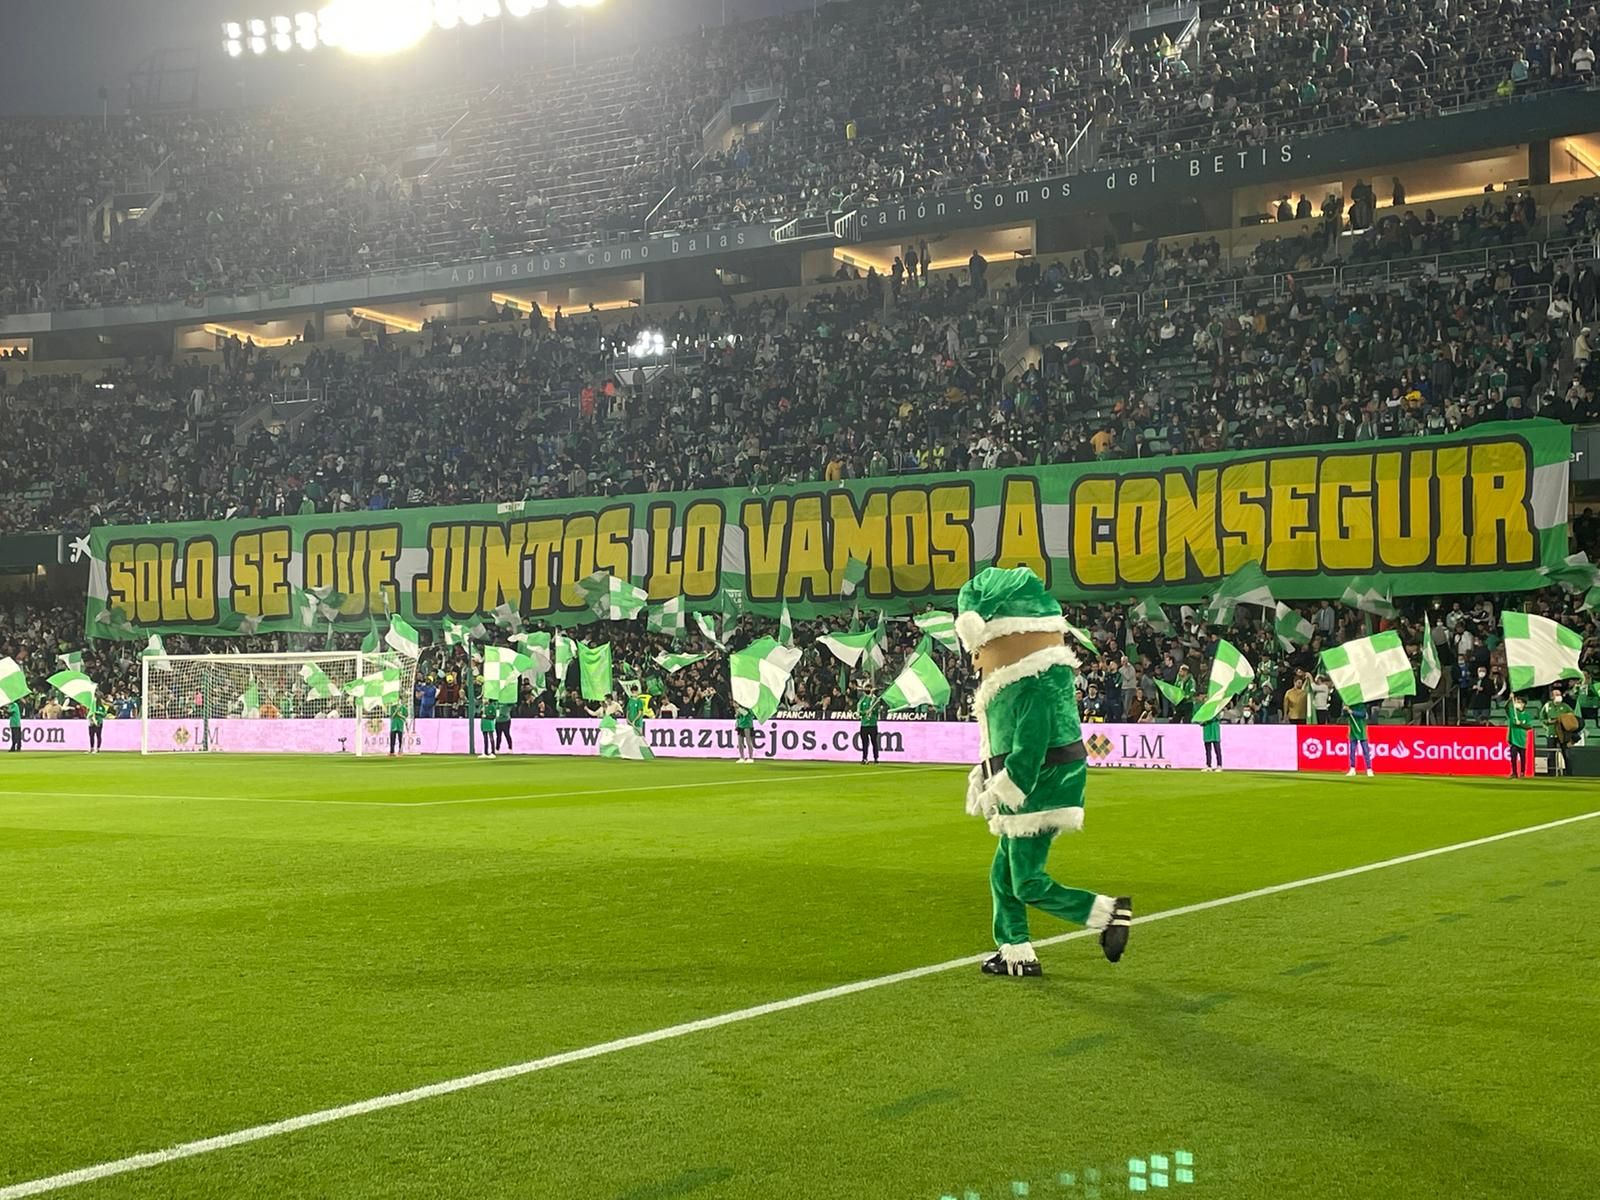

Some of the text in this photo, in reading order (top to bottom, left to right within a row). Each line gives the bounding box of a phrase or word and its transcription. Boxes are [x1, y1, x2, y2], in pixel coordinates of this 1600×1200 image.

[588, 245, 649, 264] como
[672, 231, 744, 253] balas
[974, 183, 1071, 209] Somos
[1107, 166, 1155, 189] del
[106, 534, 218, 625] SOLO
[230, 525, 293, 620] SE
[412, 503, 635, 619] JUNTOS
[645, 499, 726, 602] LO
[742, 480, 975, 602] VAMOS
[994, 474, 1051, 592] A
[1068, 434, 1540, 591] CONSEGUIR
[776, 711, 816, 720] #FANCAM
[886, 713, 928, 721] #FANCAM
[1121, 735, 1164, 759] LM
[1413, 741, 1520, 761] Santande
